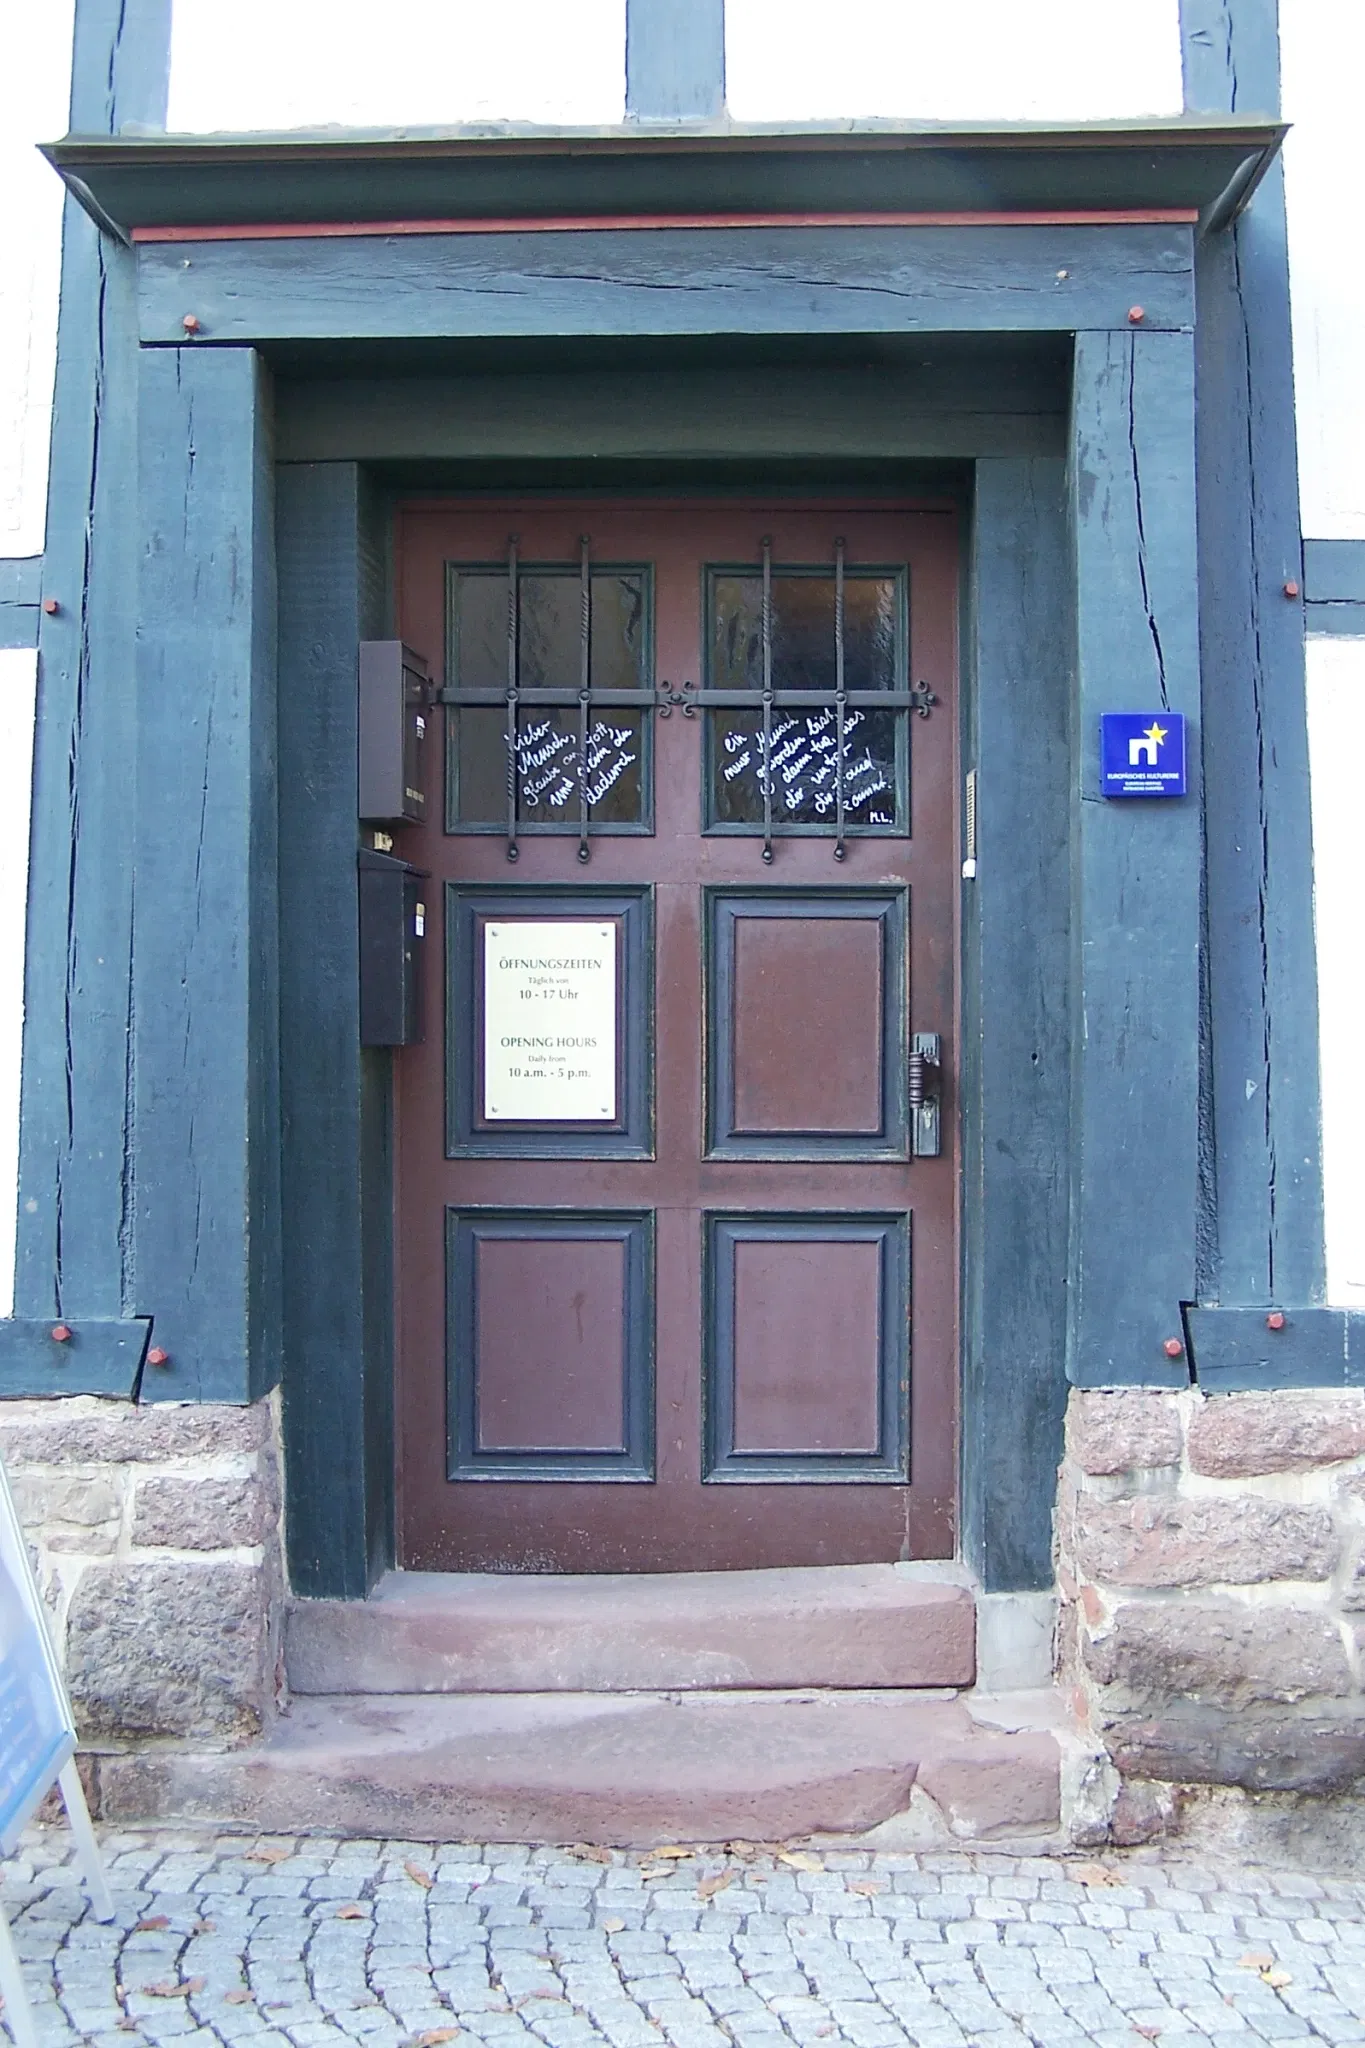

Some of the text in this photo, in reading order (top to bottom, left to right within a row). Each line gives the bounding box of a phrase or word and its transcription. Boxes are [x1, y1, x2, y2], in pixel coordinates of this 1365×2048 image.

[724, 731, 748, 753] ein
[499, 956, 602, 969] ÖFFNUNGSZEITEN
[528, 976, 554, 985] Täglich
[519, 990, 532, 999] 10
[543, 990, 555, 999] 17
[559, 989, 579, 999] Uhr
[500, 1036, 597, 1048] OPENING HOURS
[528, 1055, 547, 1063] Daily
[508, 1068, 521, 1077] 10
[524, 1068, 547, 1077] a.m.
[558, 1068, 564, 1077] 5
[567, 1069, 591, 1080] p.m.
